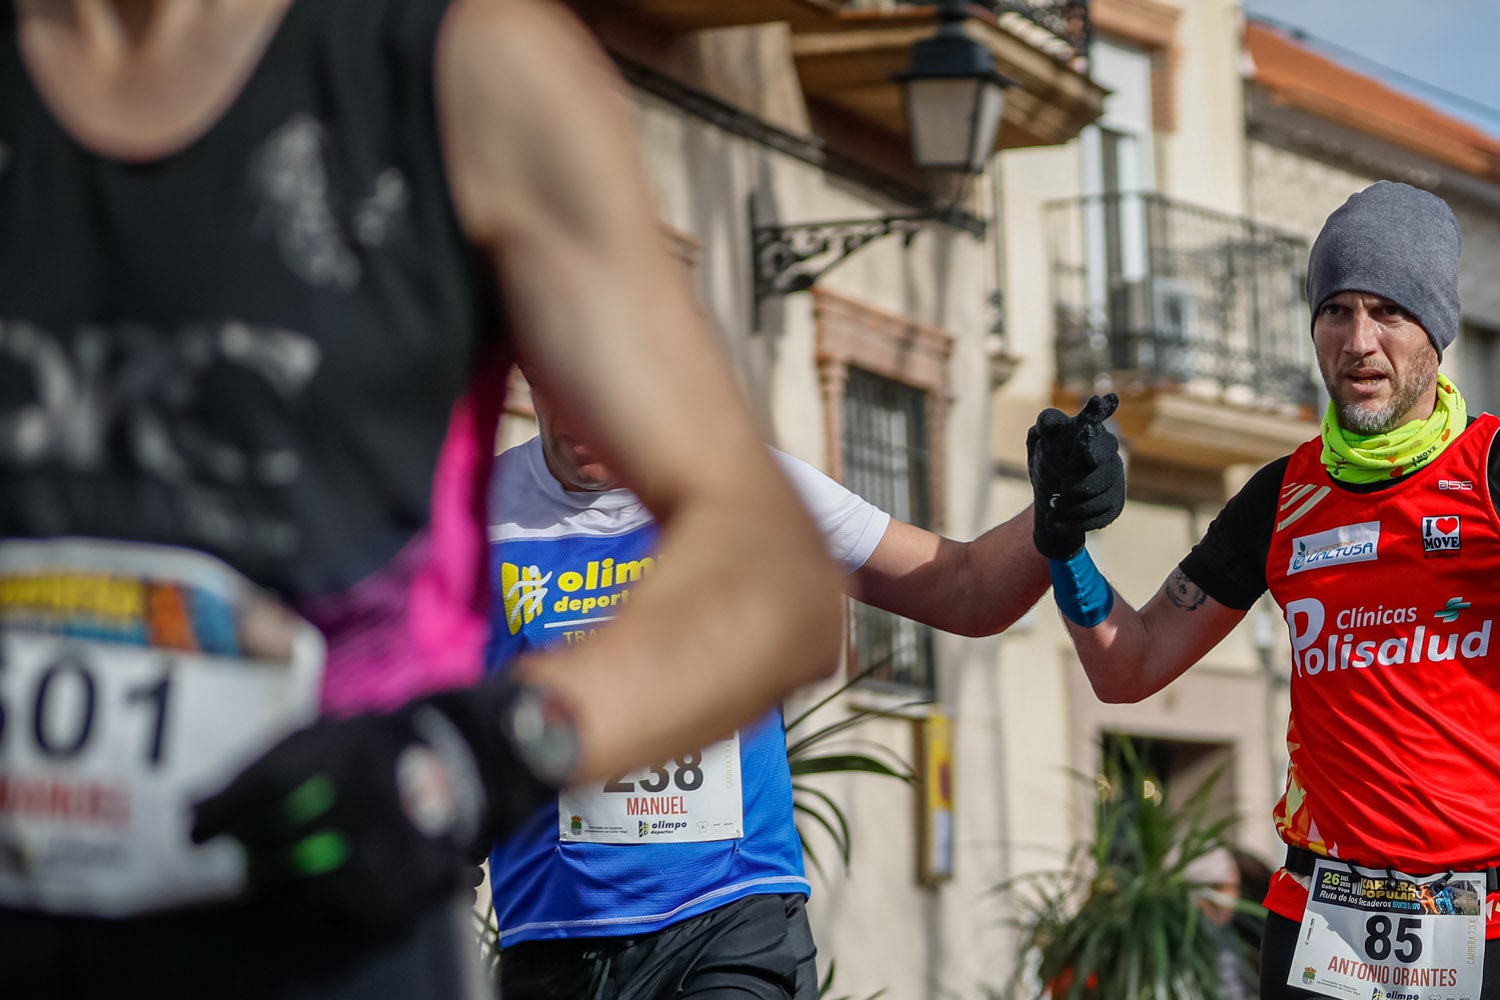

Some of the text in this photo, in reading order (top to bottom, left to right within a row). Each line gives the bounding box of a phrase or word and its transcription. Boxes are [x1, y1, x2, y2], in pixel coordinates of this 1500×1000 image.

[1426, 519, 1432, 536] I
[1424, 536, 1459, 549] MOVE
[558, 556, 664, 592] olim
[1336, 606, 1417, 630] Clínicas
[1286, 598, 1492, 678] Polisalud
[626, 796, 687, 816] MANUEL
[652, 820, 687, 830] olimpo
[1322, 871, 1340, 886] 26
[1320, 890, 1338, 900] Ruta
[1348, 895, 1358, 904] los
[1361, 890, 1416, 901] POPULAR
[1364, 915, 1422, 963] 85
[1466, 936, 1477, 965] CARRERA
[1328, 955, 1457, 986] ANTONIO ORANTES
